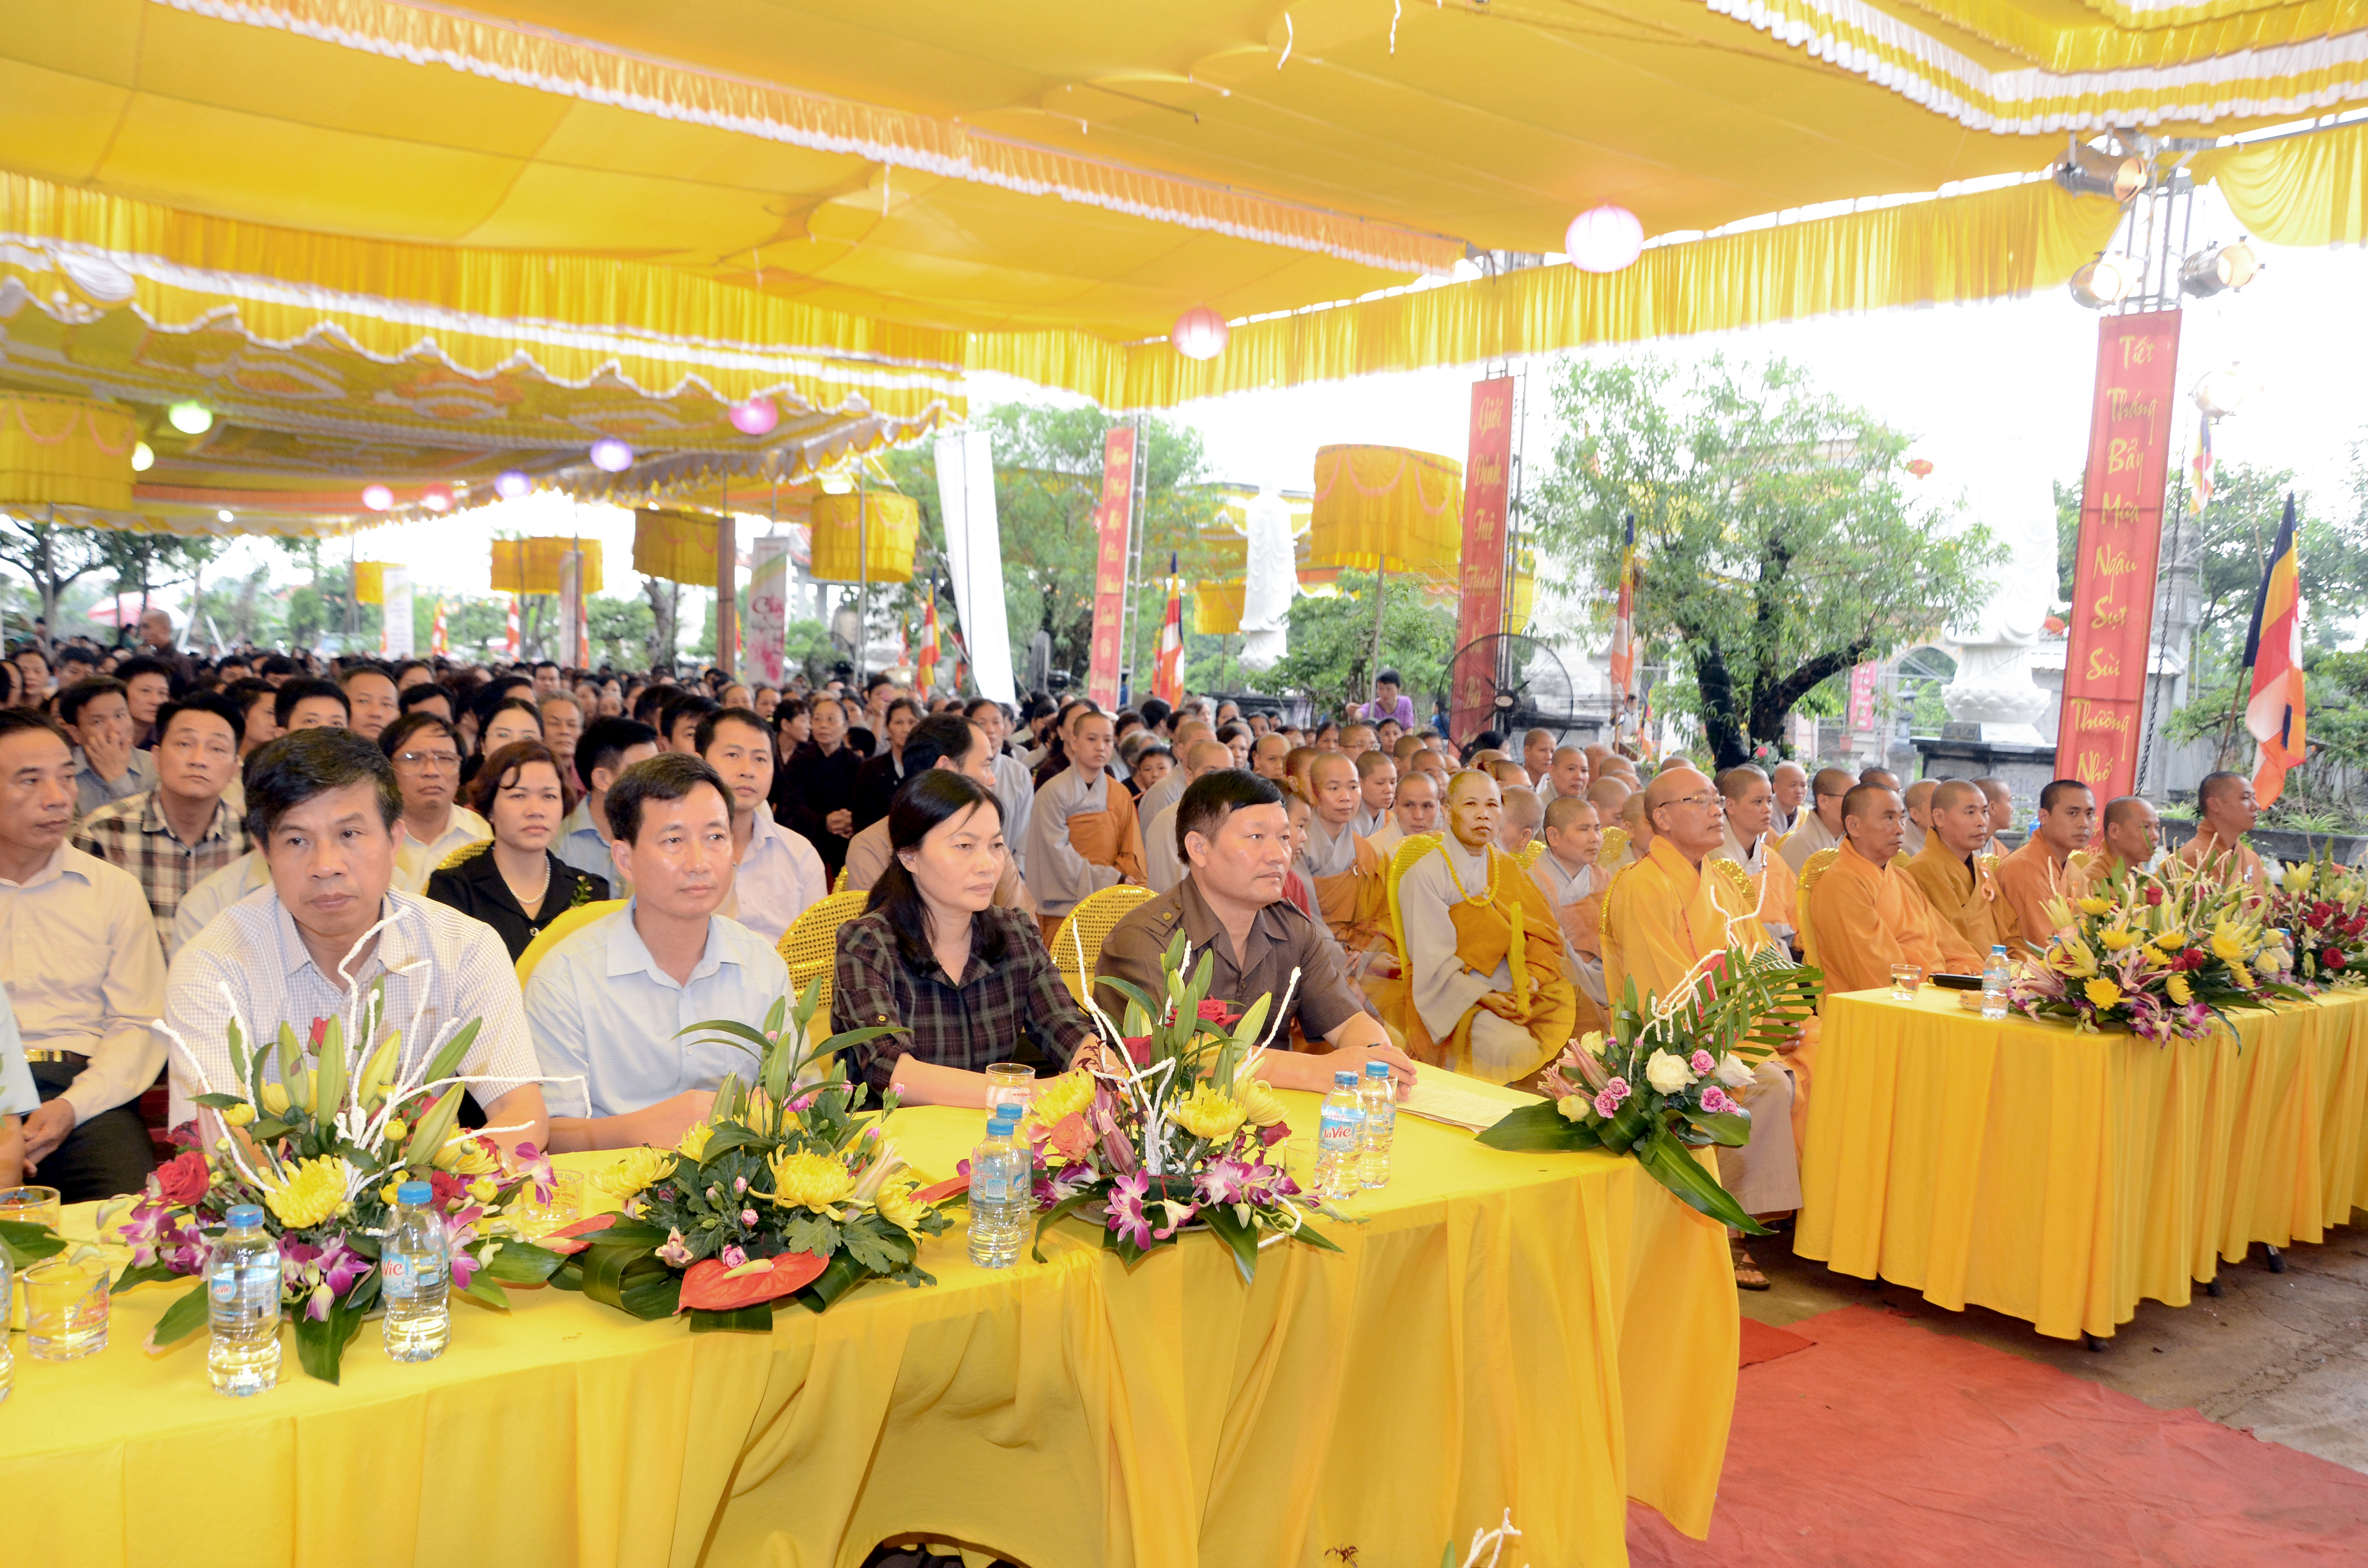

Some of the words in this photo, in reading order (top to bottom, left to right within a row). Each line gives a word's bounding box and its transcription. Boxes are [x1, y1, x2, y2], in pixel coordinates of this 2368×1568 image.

[2119, 334, 2155, 371] Tiết
[2107, 387, 2157, 446] Tháng
[2092, 543, 2138, 603] Ngâu
[2091, 595, 2128, 630] Sụt
[2086, 646, 2121, 681] Sùi
[2071, 697, 2131, 762] Thương
[2076, 749, 2113, 784] Nhớ
